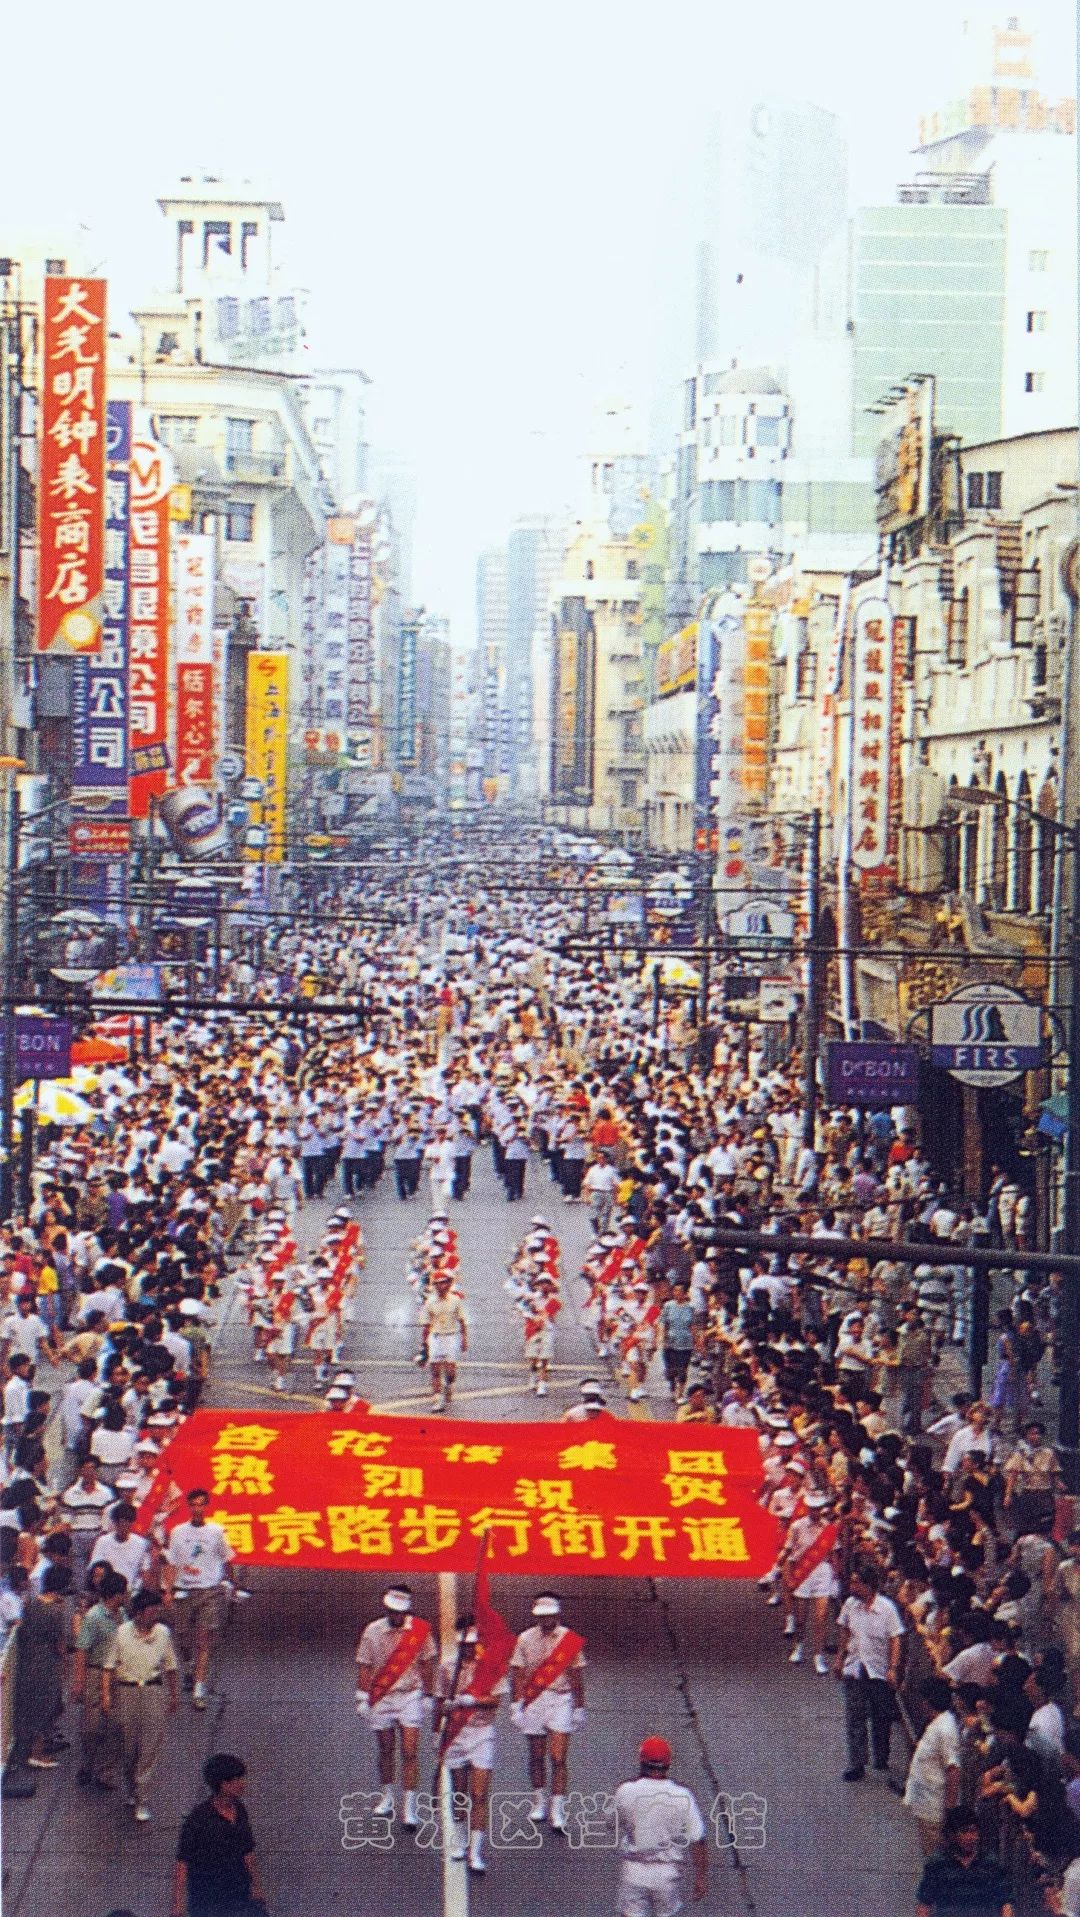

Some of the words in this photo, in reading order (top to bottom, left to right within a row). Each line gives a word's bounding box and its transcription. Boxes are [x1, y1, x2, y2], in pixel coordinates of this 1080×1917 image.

[46, 283, 100, 605] 大光明钟表商店
[954, 1047, 1018, 1068] FIRS
[210, 1452, 728, 1512] 热烈祝贺
[204, 1503, 751, 1561] 南京路步行街开通
